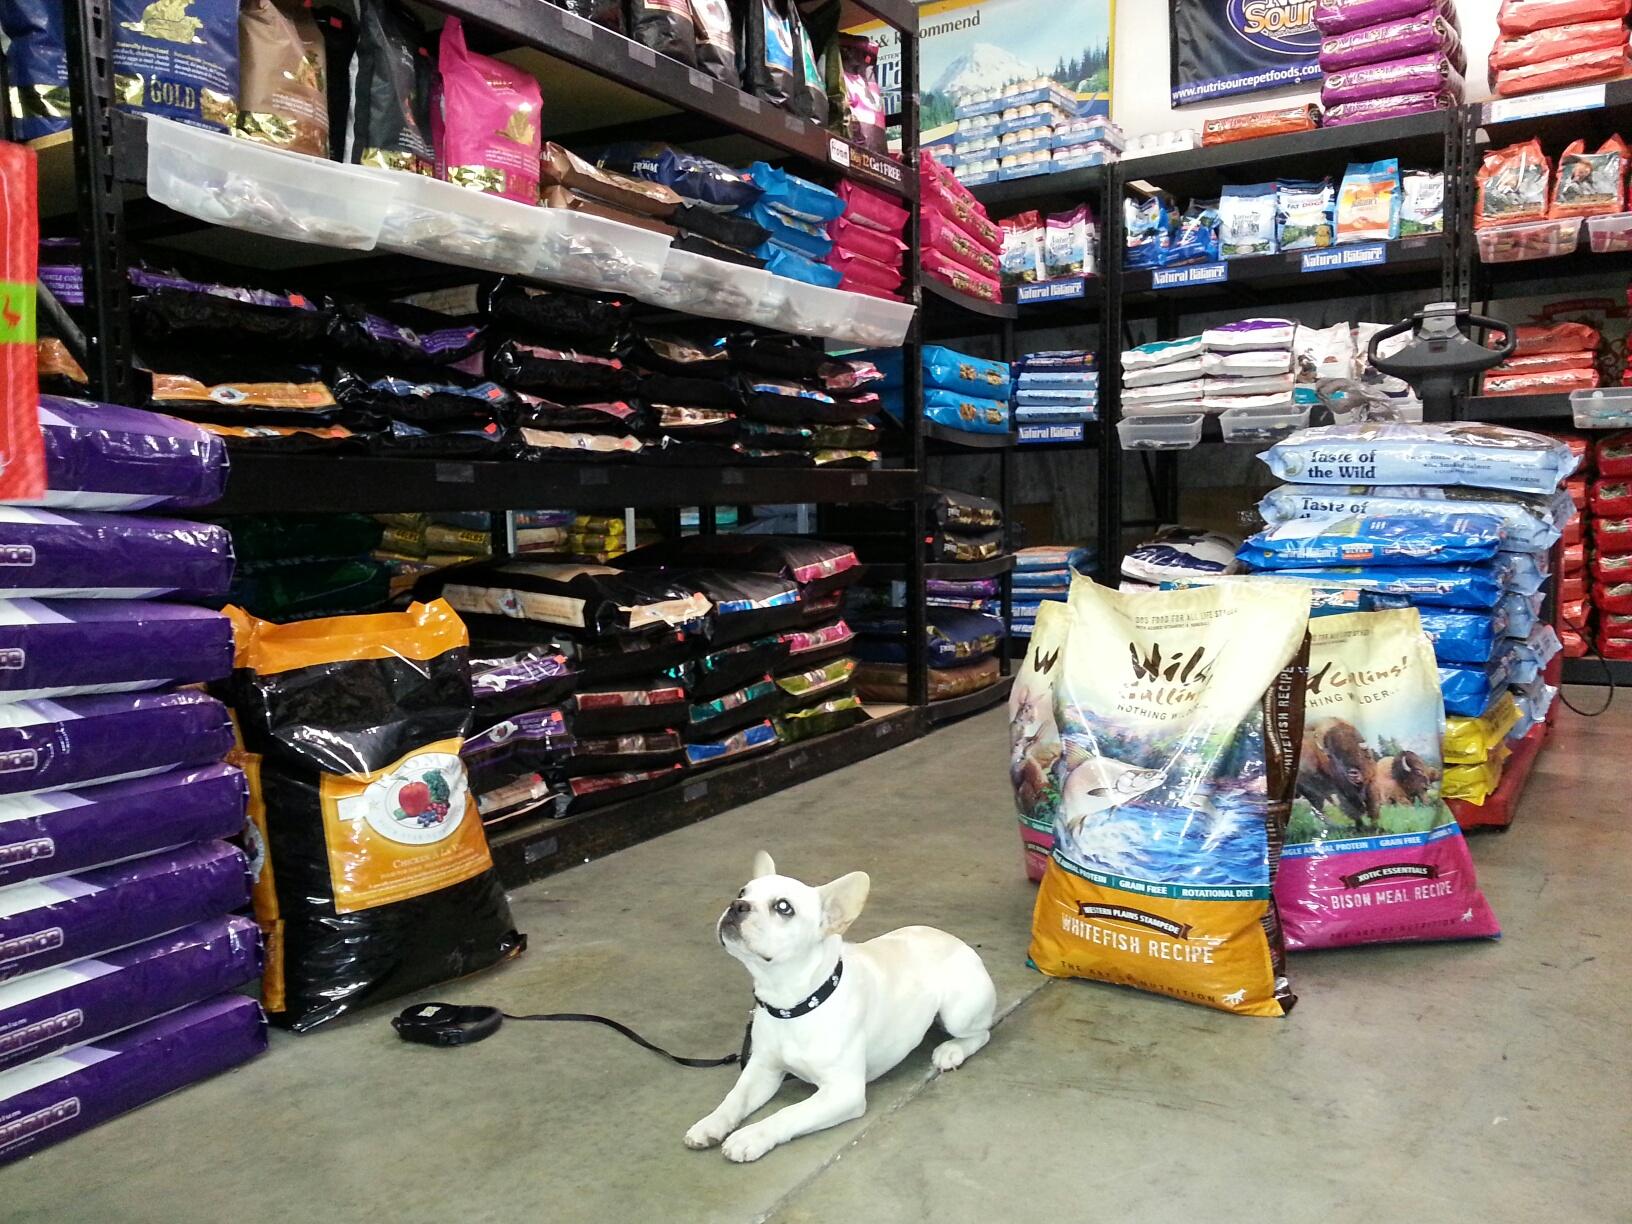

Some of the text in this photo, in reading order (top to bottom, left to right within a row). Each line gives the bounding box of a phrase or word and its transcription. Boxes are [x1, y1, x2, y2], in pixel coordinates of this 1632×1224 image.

[150, 79, 195, 110] GOLD
[884, 162, 901, 181] FREE
[1303, 247, 1383, 267] Natural Balance
[1153, 265, 1225, 285] Natural Balance
[1018, 282, 1082, 299] Natural Balance
[1019, 426, 1082, 438] Natural Balance
[1310, 449, 1377, 464] Taste of
[1308, 466, 1376, 479] the Wild
[1301, 497, 1369, 514] Taste of
[1277, 666, 1295, 707] RECIPE
[1117, 704, 1167, 721] NOTHING
[1335, 842, 1369, 851] PROTEIN
[1379, 838, 1403, 847] GRAIN
[1404, 837, 1421, 845] FREE
[1383, 867, 1428, 876] ESSENTIALS
[1080, 869, 1107, 884] PROTEIN
[1119, 879, 1146, 893] GRAIN
[1146, 883, 1168, 895] FREE
[1182, 888, 1235, 898] ROTATIONAL
[1236, 889, 1254, 898] DIET
[1331, 881, 1454, 910] BISON MEAL RECIPE
[1083, 905, 1180, 935] WESTERN PLAINS STAMPEDE
[1061, 914, 1215, 964] WHITEFISH RECIPE
[1060, 960, 1082, 972] THE
[1140, 980, 1217, 1003] NUTRITION
